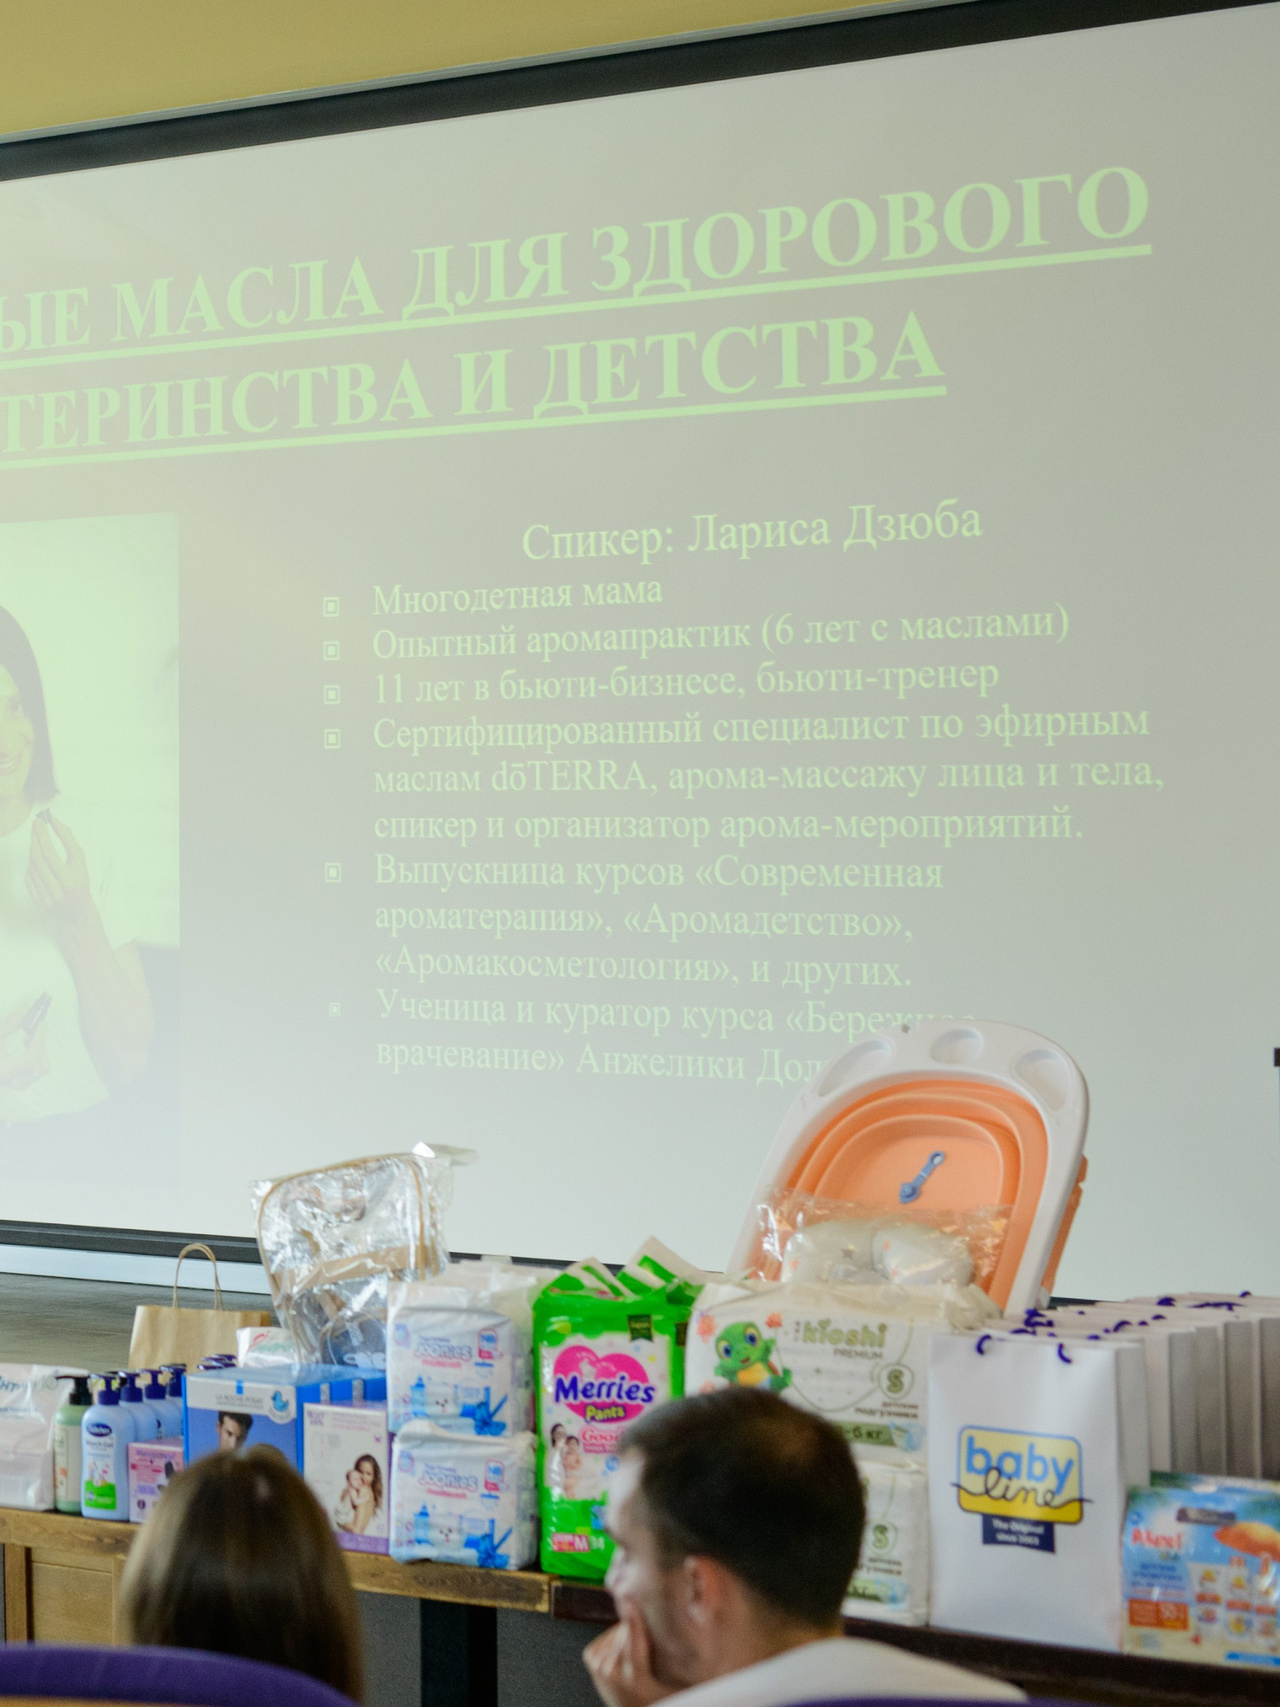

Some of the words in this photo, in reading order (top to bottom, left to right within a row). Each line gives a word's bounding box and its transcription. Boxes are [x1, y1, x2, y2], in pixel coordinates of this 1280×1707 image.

[115, 256, 383, 341] МАСЛА
[402, 231, 569, 321] ДЛЯ
[591, 166, 1150, 298] ЗДОРОВОГО
[453, 349, 514, 416] И
[533, 310, 945, 420] ДЕТСТВА
[523, 524, 674, 565] Спикер:
[687, 514, 832, 560] Лариса
[843, 498, 984, 553] Дзюба
[372, 584, 574, 615] Многодетная
[582, 580, 663, 606] мама
[373, 624, 517, 660] Опытный
[526, 624, 751, 662] аромапрактик
[761, 613, 794, 653] (6
[803, 619, 861, 644] лет
[871, 619, 889, 641] с
[900, 602, 1070, 644] маслами)
[375, 673, 404, 702] 11
[416, 679, 465, 701] лет
[474, 679, 490, 699] в
[499, 666, 745, 700] бьюти-бизнесе,
[756, 662, 999, 698] бьюти-тренер
[373, 712, 703, 756] Сертифицированный
[713, 715, 910, 745] специалист
[920, 714, 964, 738] по
[974, 703, 1150, 747] эфирным
[375, 771, 481, 792] маслам
[668, 762, 927, 799] арома-массажу
[937, 763, 1025, 791] лица
[1036, 763, 1058, 786] и
[1070, 760, 1164, 792] тела,
[374, 816, 477, 848] спикер
[486, 816, 506, 838] и
[515, 815, 711, 848] организатор
[721, 804, 1084, 849] арома-мероприятий.
[375, 853, 566, 893] Выпускница
[575, 862, 685, 894] курсов
[695, 854, 945, 897] «Современная
[375, 906, 613, 940] ароматерапия»,
[623, 902, 913, 943] «Аромадетство»,
[376, 943, 740, 987] «Аромакосметология»,
[750, 960, 771, 982] и
[782, 960, 912, 995] других.
[375, 988, 507, 1027] Ученица
[516, 1001, 535, 1024] и
[544, 1001, 671, 1037] куратор
[681, 1005, 775, 1039] курса
[376, 1043, 565, 1075] врачевание»
[575, 1043, 746, 1079] Анжелики
[802, 1318, 888, 1349] kioshi
[554, 1375, 656, 1404] Merries
[886, 1368, 905, 1394] S
[585, 1404, 627, 1423] Pants
[966, 1435, 1074, 1496] baby
[956, 1466, 1086, 1509] line
[872, 1524, 889, 1550] S
